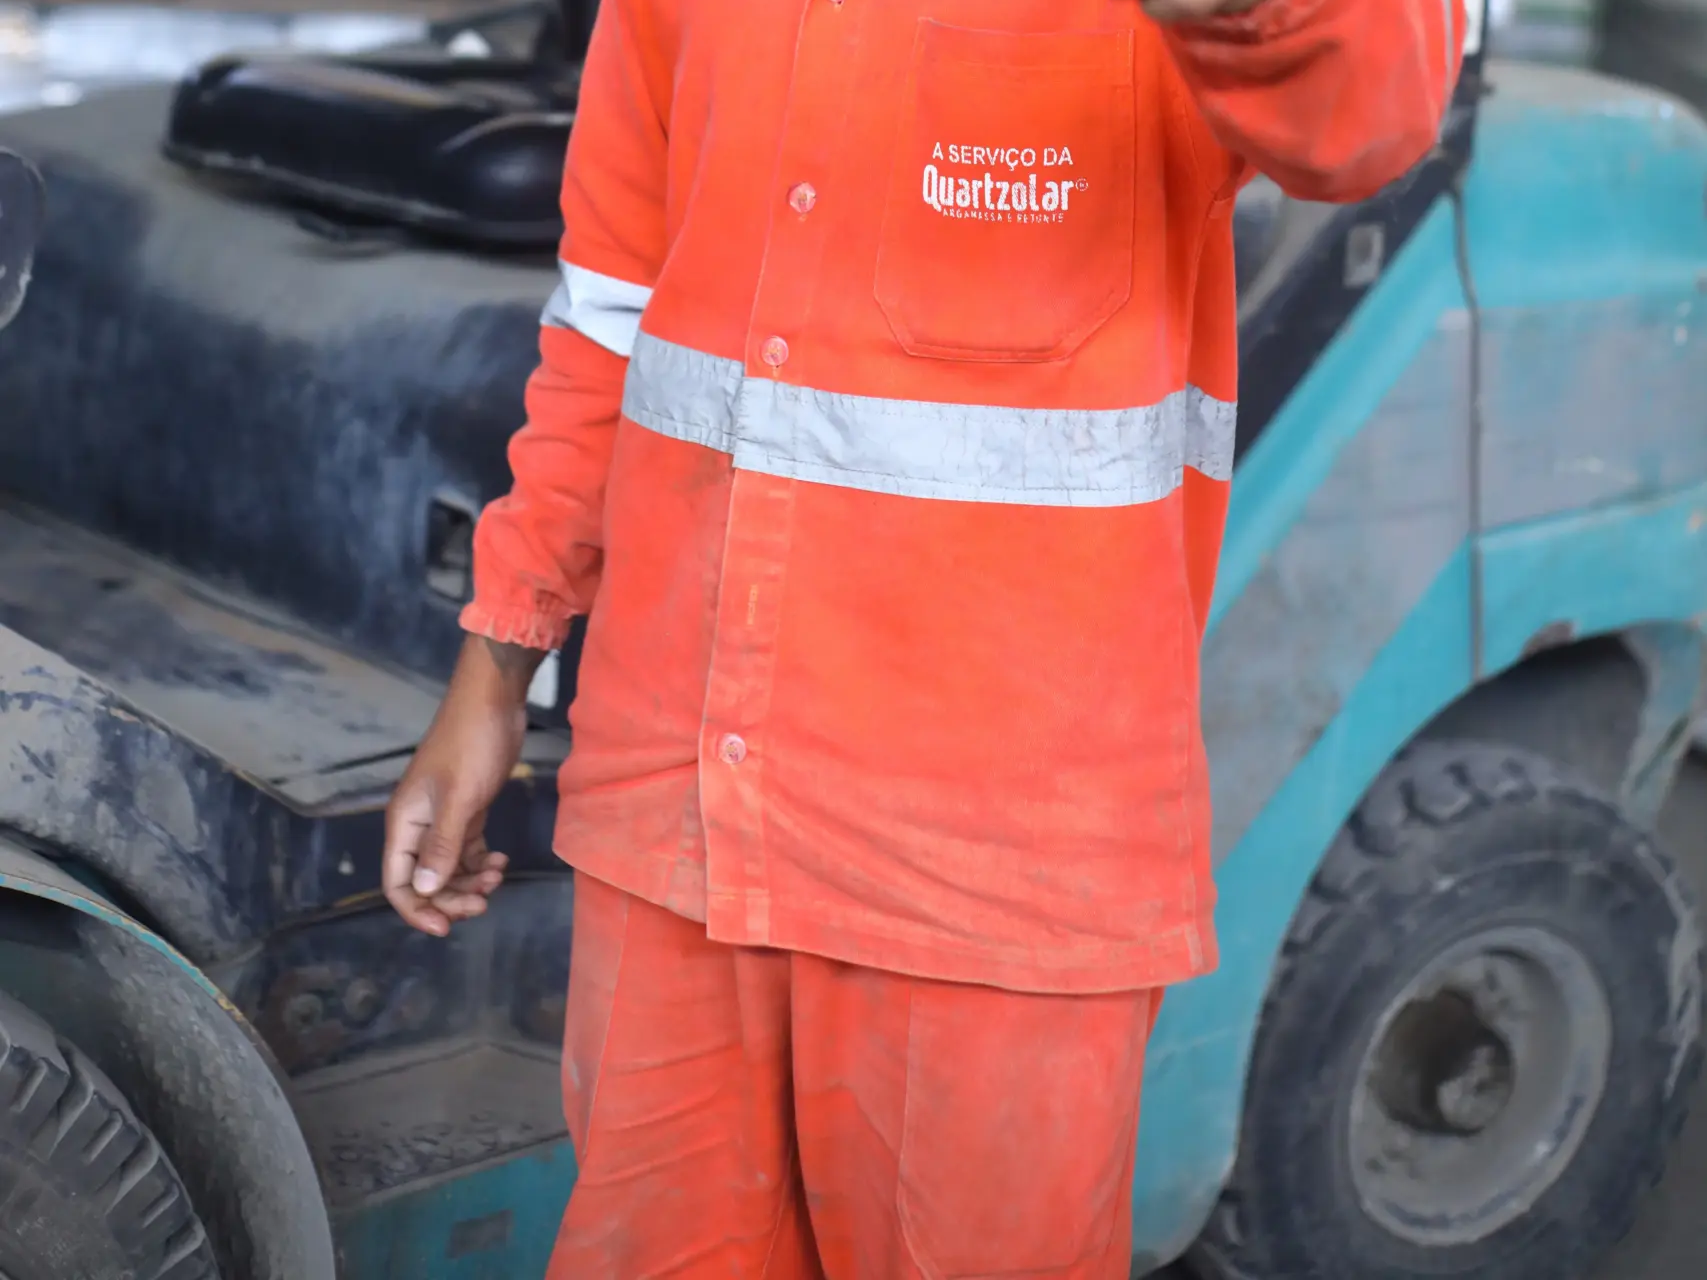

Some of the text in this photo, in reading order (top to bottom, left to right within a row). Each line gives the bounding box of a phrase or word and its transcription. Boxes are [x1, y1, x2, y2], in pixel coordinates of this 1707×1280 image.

[932, 141, 1074, 171] A SERVIÇO DA
